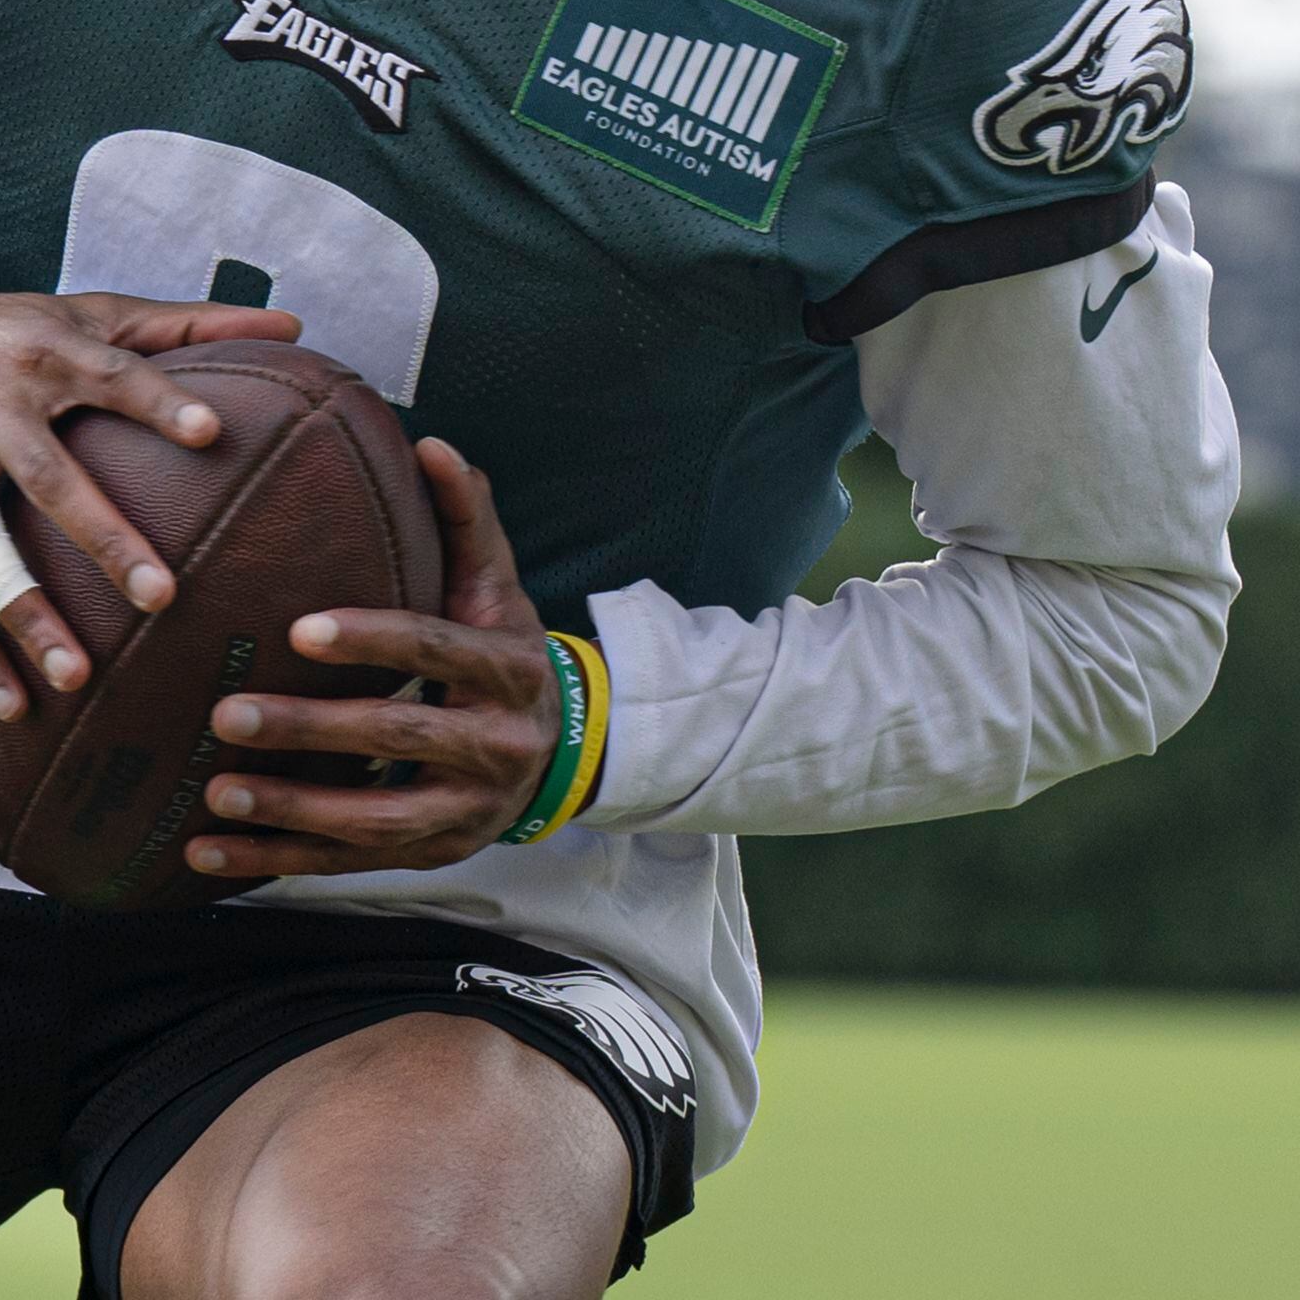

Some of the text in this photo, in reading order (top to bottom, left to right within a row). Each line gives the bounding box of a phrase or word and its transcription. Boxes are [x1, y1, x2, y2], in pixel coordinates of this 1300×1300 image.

[540, 56, 779, 183] EAGLES AUTISM
[584, 109, 713, 177] FOUNDATION
[565, 669, 586, 746] WHAT
